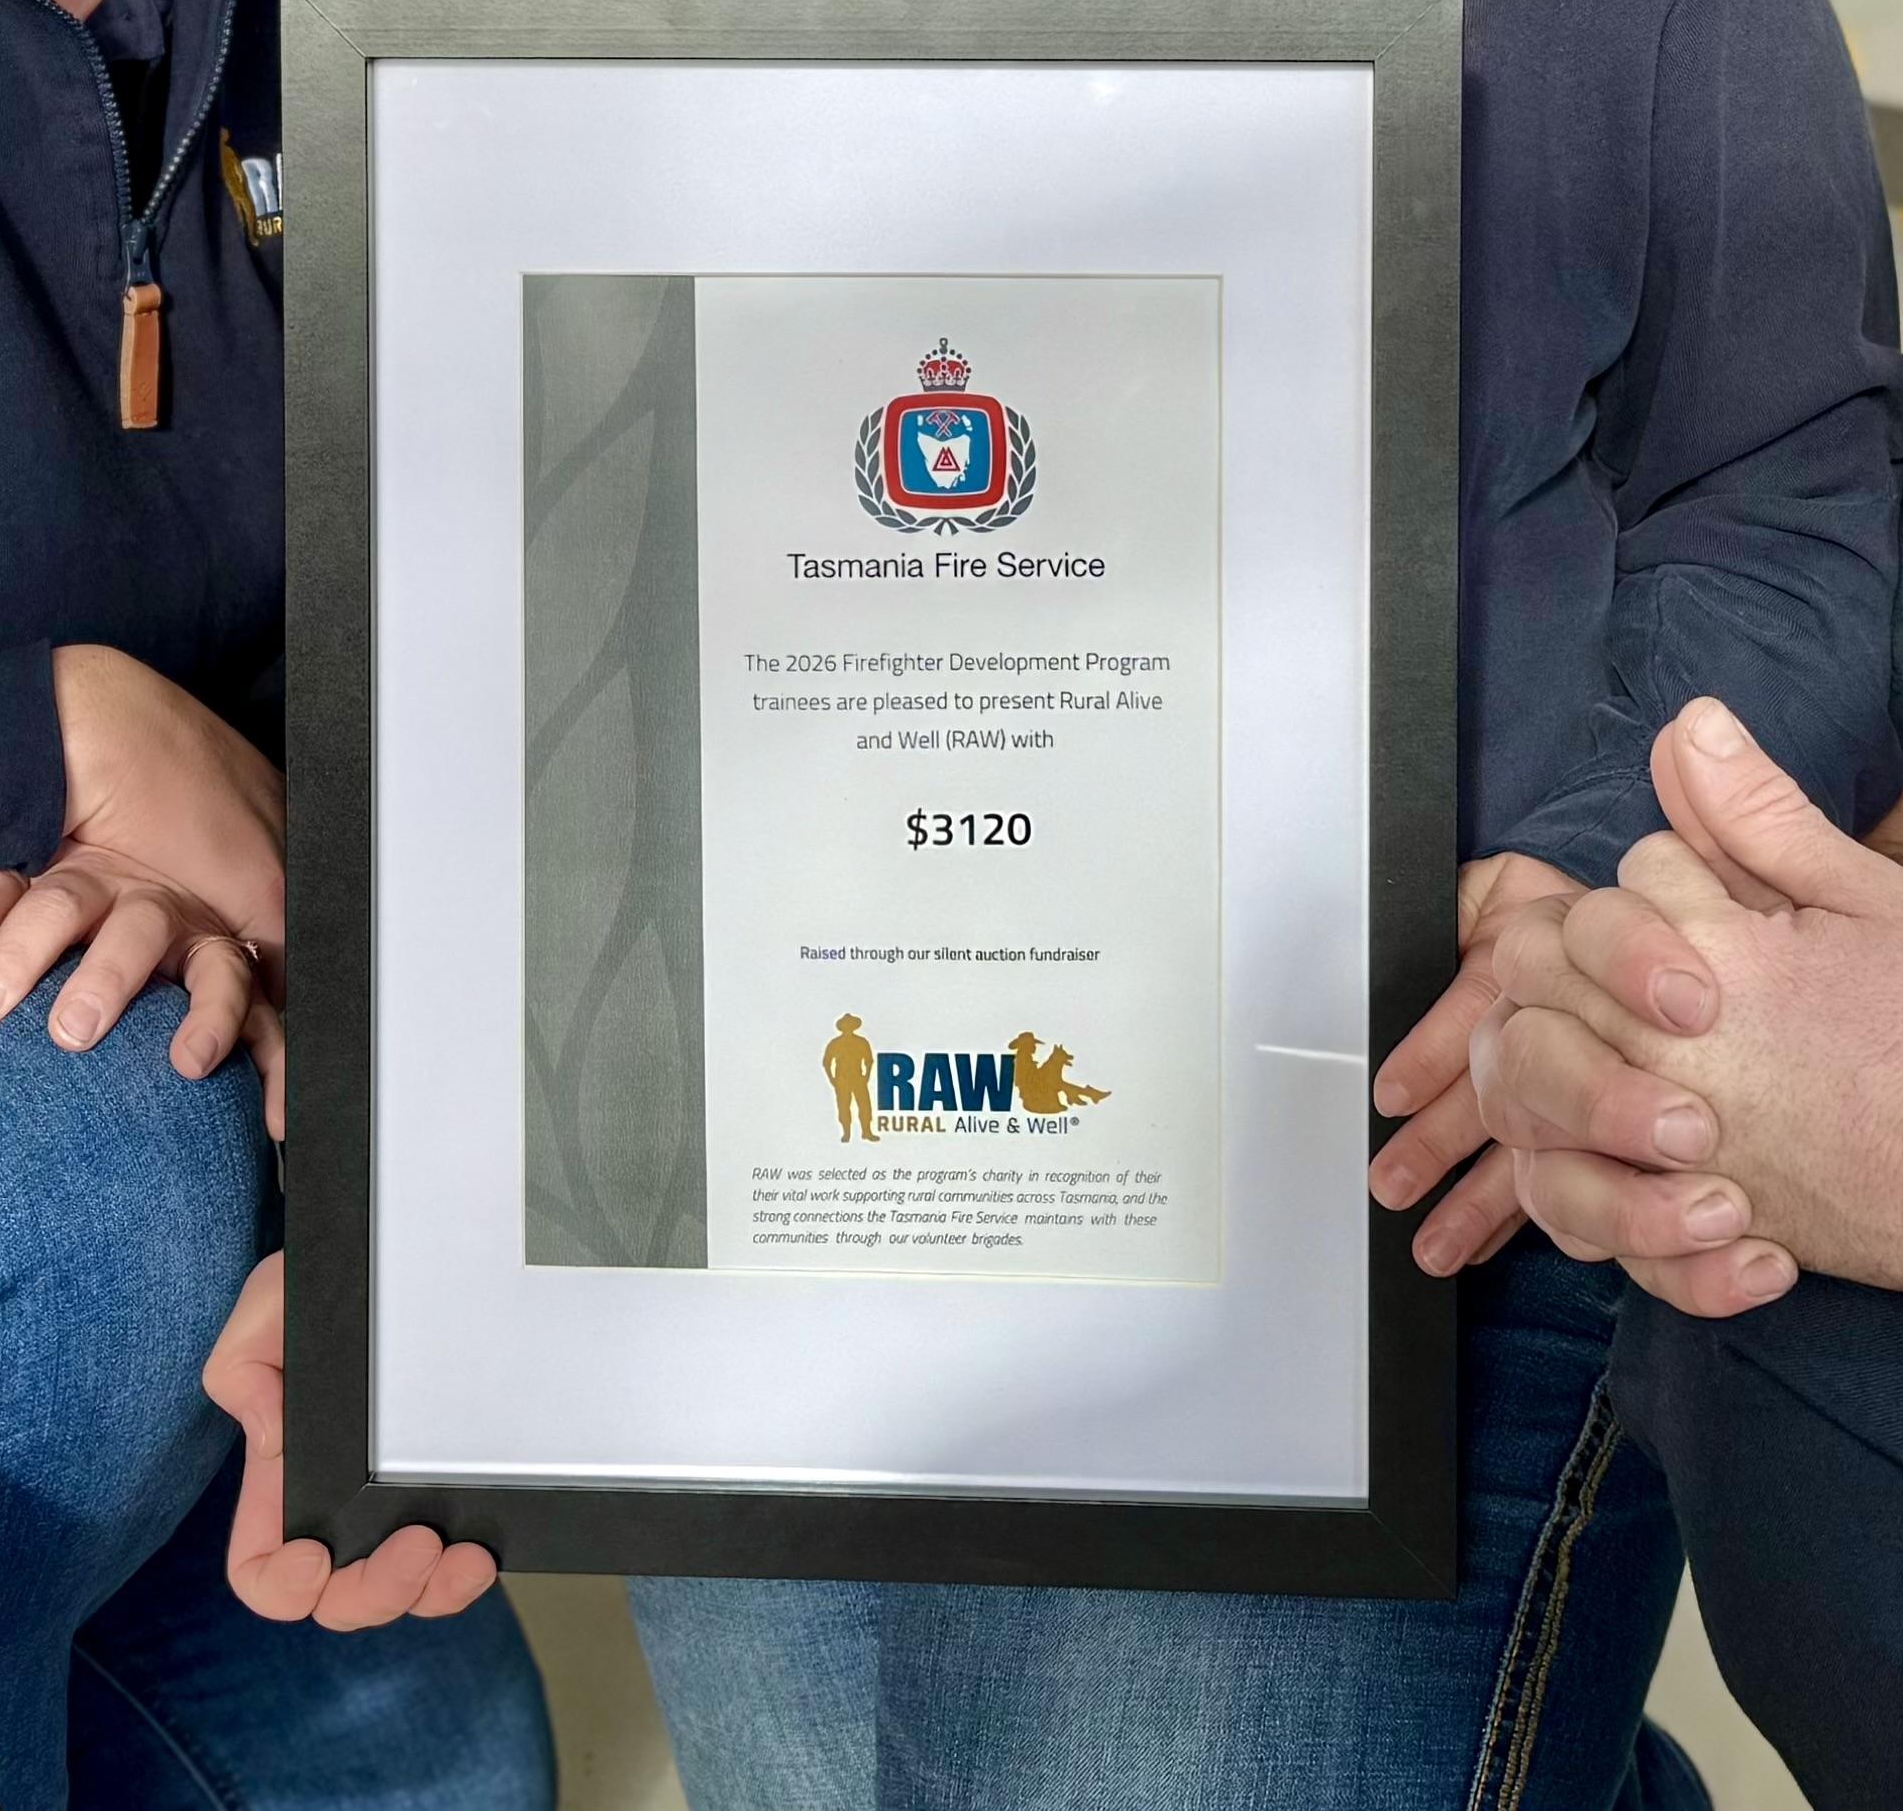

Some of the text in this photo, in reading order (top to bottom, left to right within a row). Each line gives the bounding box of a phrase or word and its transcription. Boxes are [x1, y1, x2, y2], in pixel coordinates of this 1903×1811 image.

[787, 552, 1105, 578] Tasmania Fire Service
[744, 652, 1170, 676] The 2026 Firefighter Development Program
[753, 691, 1162, 715] trainees are pleased to present Rural Alive
[857, 729, 1053, 751] and Well (RAW) with
[907, 808, 1031, 851] $3120
[801, 946, 1100, 963] Raised through our silent auction fundraiser
[877, 1052, 1016, 1112] RAW
[876, 1115, 947, 1133] RURAL
[955, 1115, 999, 1133] Alive
[1007, 1117, 1020, 1133] &
[752, 1167, 783, 1180] RAW
[787, 1170, 812, 1180] was
[819, 1167, 867, 1181] selected
[872, 1170, 886, 1180] as
[893, 1168, 912, 1180] the
[982, 1169, 1023, 1185] charity
[1029, 1170, 1039, 1181] in
[1045, 1170, 1110, 1186] recognition
[1116, 1169, 1130, 1186] of
[1135, 1170, 1162, 1184] their
[752, 1189, 1169, 1205] their vital work supporting rural communities across Tasmania, and the
[753, 1210, 1158, 1226] strong connections the Tasmania Fire Service maintains with these
[753, 1231, 1023, 1249] communities through our volunteer brigades.
